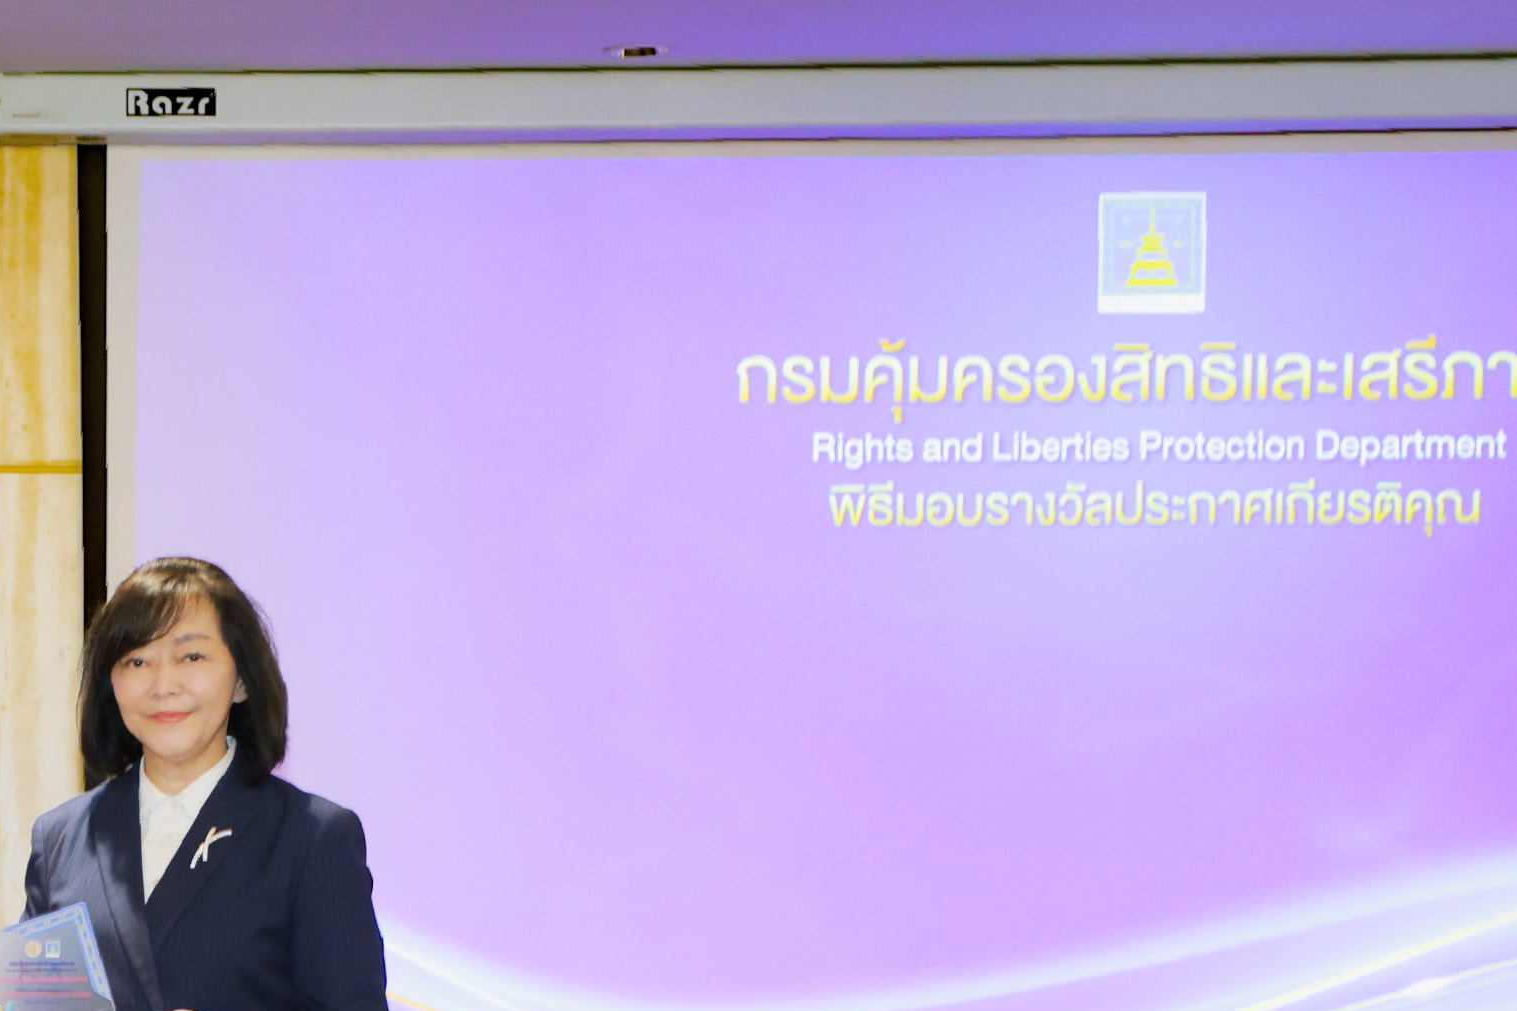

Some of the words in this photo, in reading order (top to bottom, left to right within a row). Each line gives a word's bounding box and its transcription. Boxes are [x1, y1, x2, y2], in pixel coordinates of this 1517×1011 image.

[127, 89, 210, 115] Razr
[811, 431, 914, 468] Rights
[922, 431, 983, 463] and
[992, 431, 1130, 463] Liberties
[1139, 430, 1305, 462] Protection
[1315, 428, 1508, 467] Department
[829, 479, 1482, 537] พิธีมอบรางวัลประกาศเกียรติคุณ
